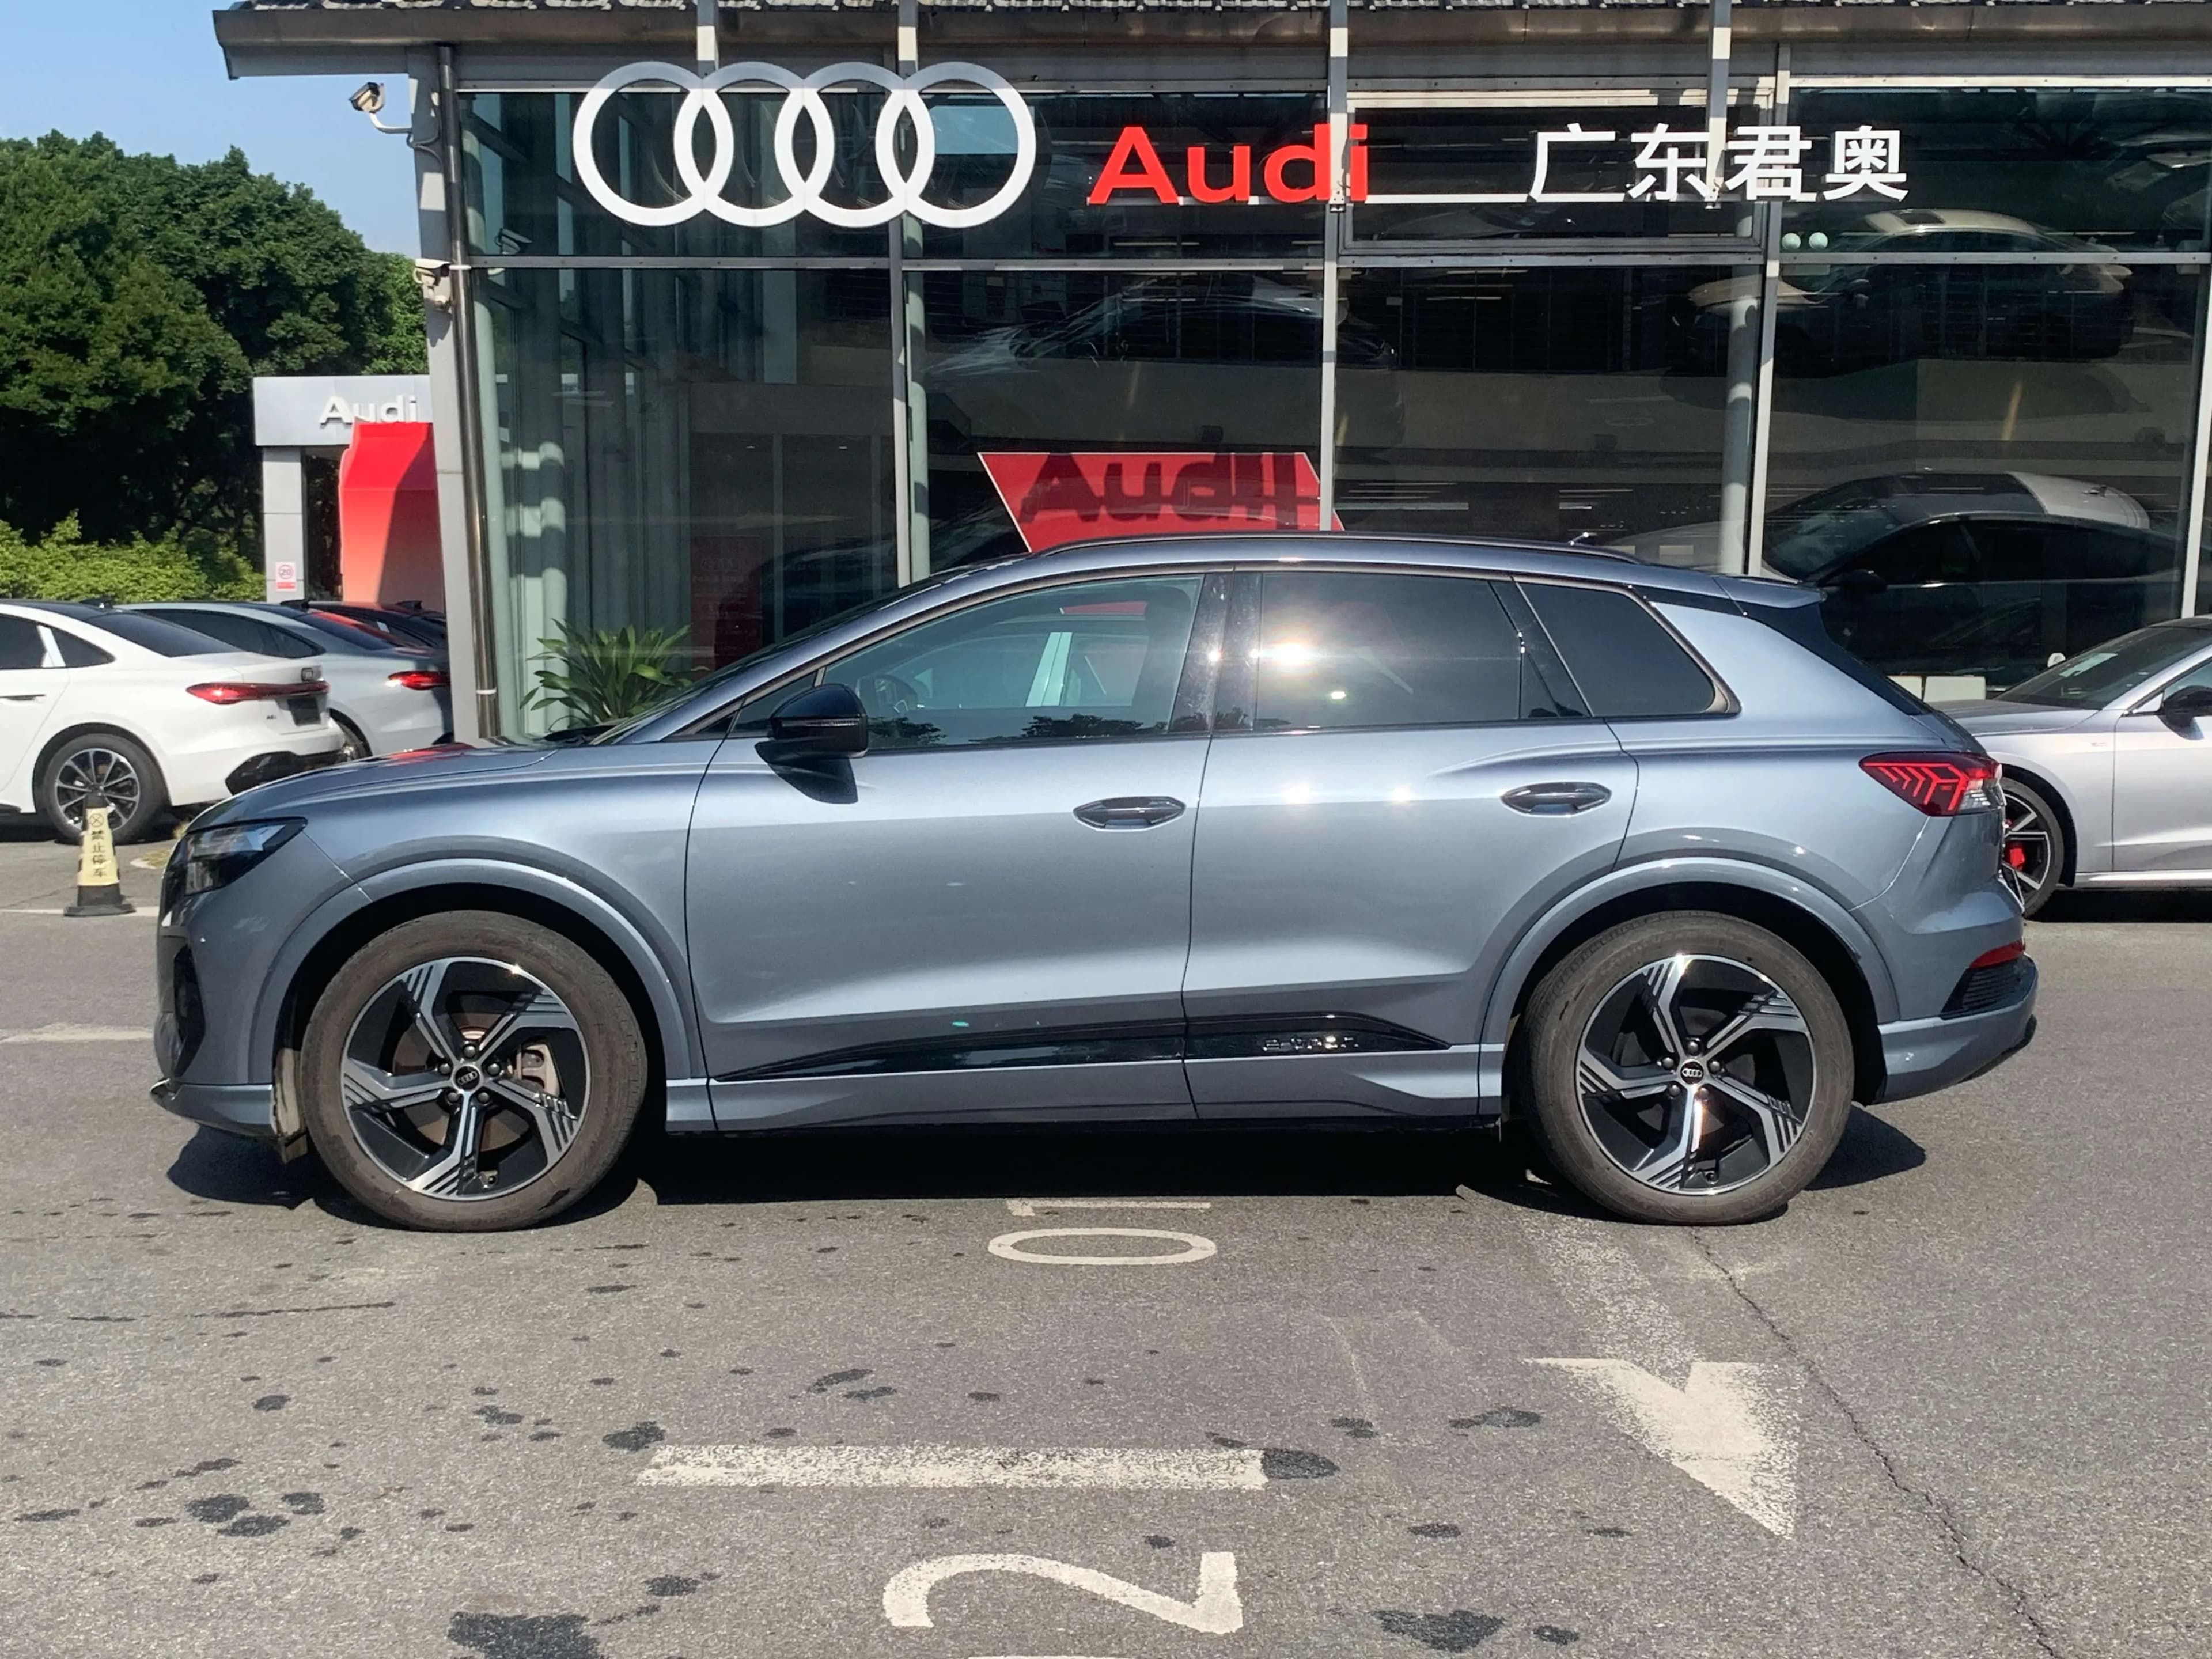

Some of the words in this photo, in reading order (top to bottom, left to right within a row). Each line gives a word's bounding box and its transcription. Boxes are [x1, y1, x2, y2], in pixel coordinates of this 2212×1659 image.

[1088, 124, 1368, 204] Audi
[1528, 122, 1909, 202] 广东君奥
[318, 395, 416, 423] Audi
